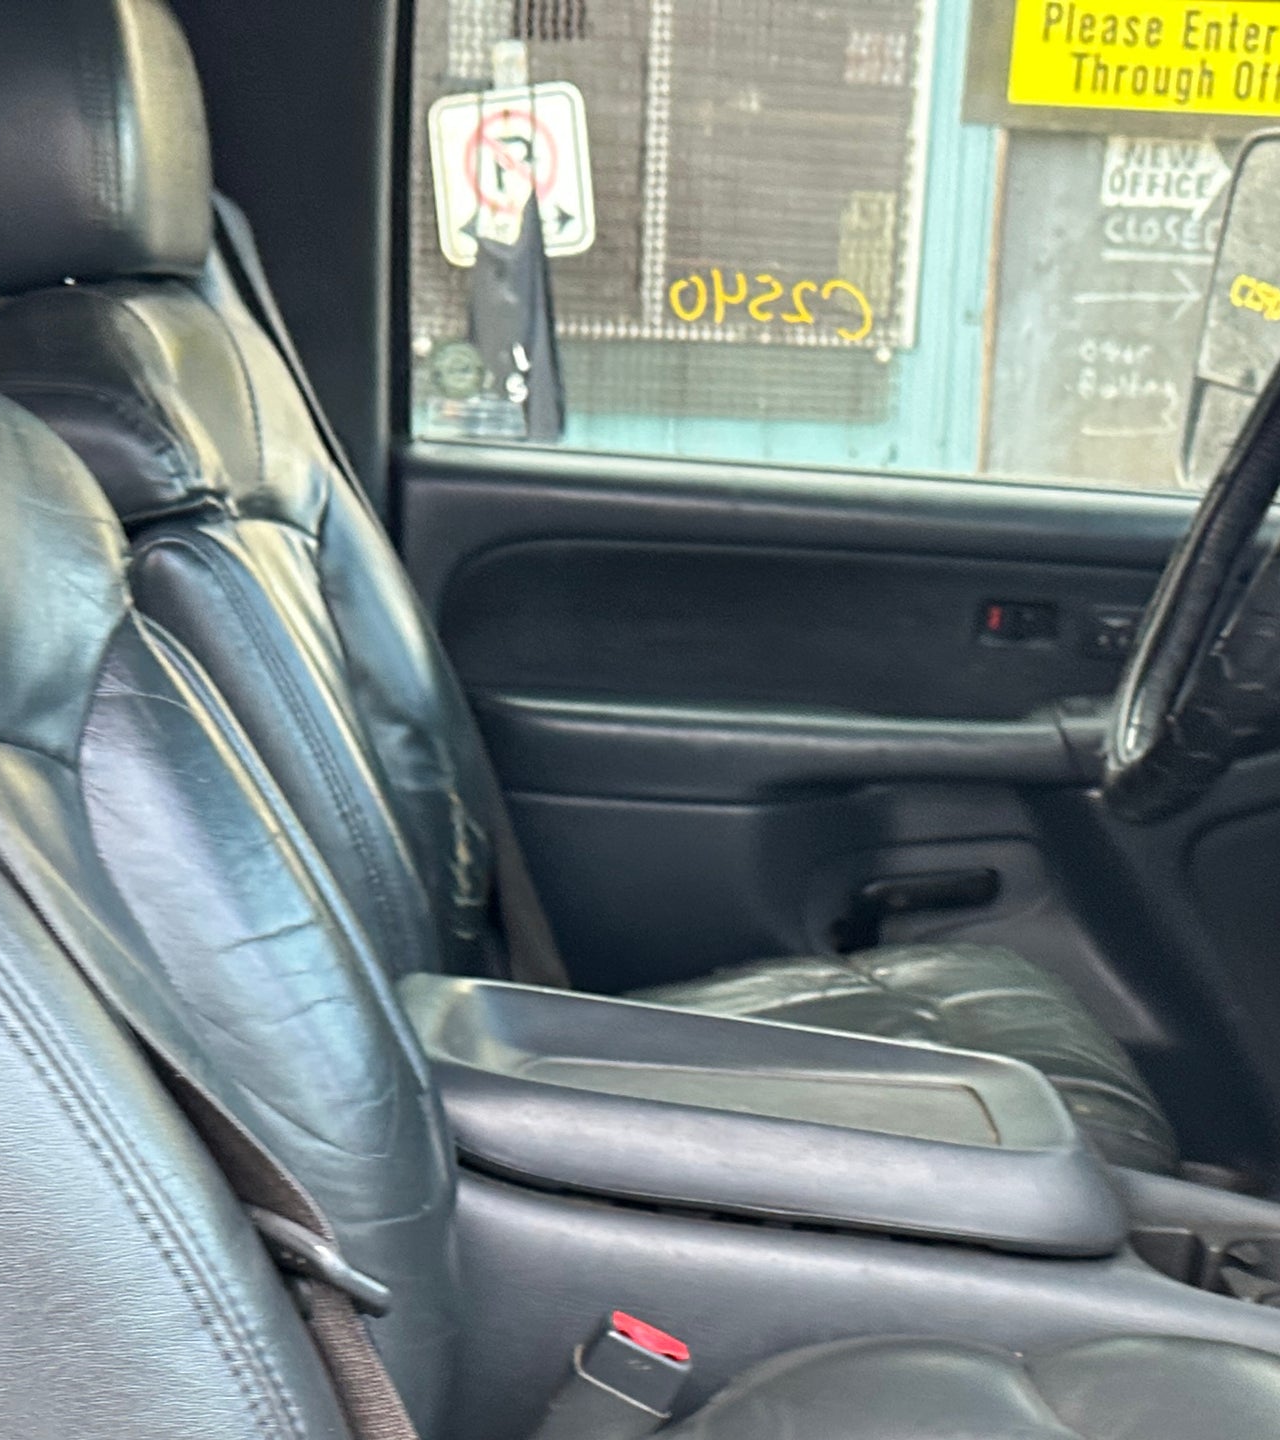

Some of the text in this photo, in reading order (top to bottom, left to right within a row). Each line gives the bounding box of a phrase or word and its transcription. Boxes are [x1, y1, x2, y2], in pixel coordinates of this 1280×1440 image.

[1043, 2, 1163, 49] Please
[1183, 10, 1278, 56] Enter
[1071, 52, 1215, 105] Through
[1109, 167, 1212, 199] OFFICE
